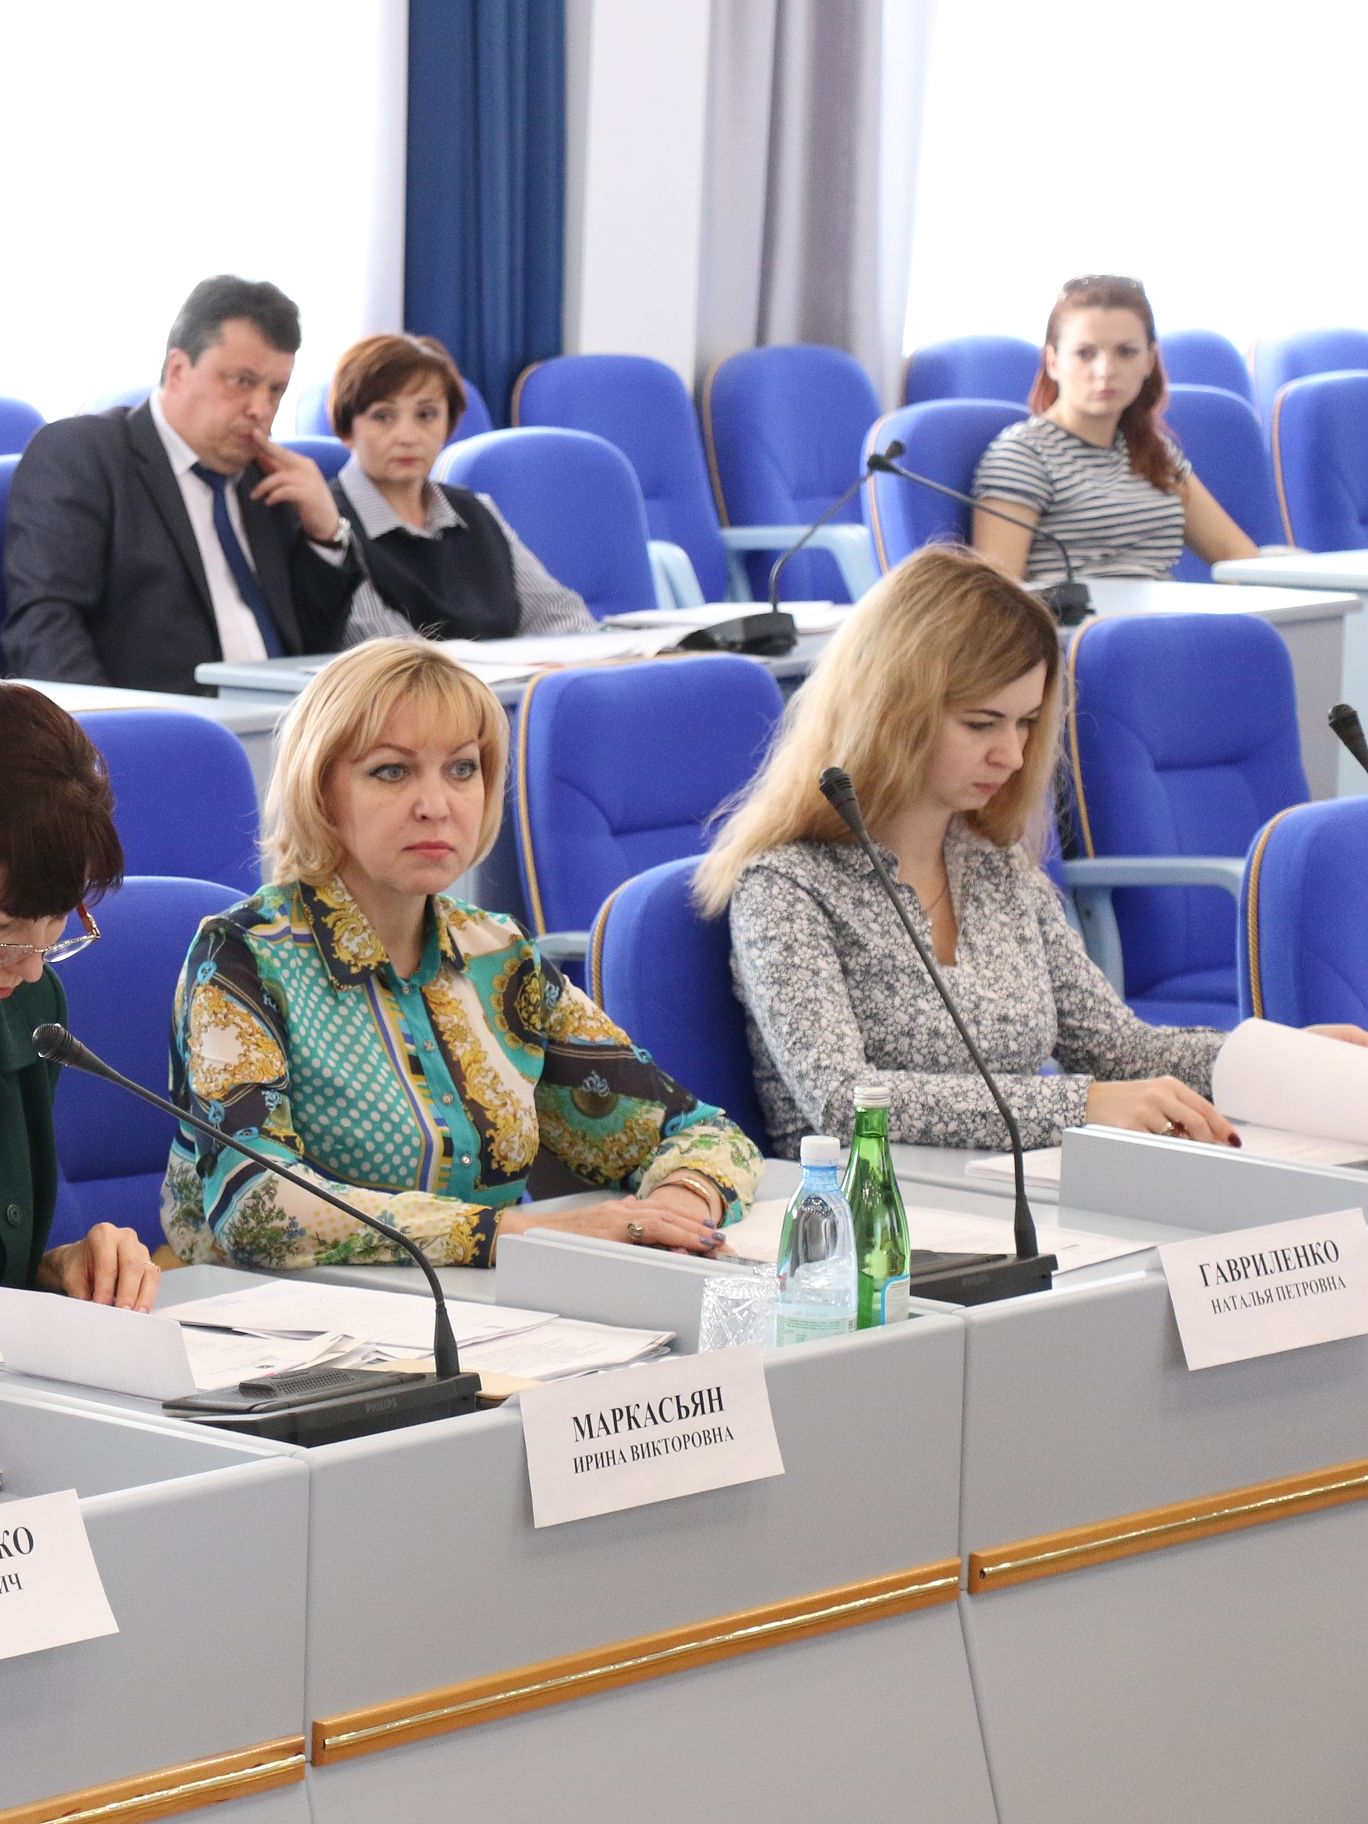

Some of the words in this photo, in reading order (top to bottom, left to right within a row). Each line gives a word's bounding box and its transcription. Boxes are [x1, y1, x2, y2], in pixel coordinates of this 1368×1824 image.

[1198, 1239, 1340, 1288] ГАВРИЛЕНКО
[1211, 1285, 1275, 1315] НАТАЛЬЯ
[1275, 1275, 1347, 1302] ПЕТРОВНА
[571, 1386, 726, 1442] МАРКАСЬЯН
[573, 1448, 628, 1474] ИРИНА
[630, 1425, 735, 1462] ВИКТОРОВНА
